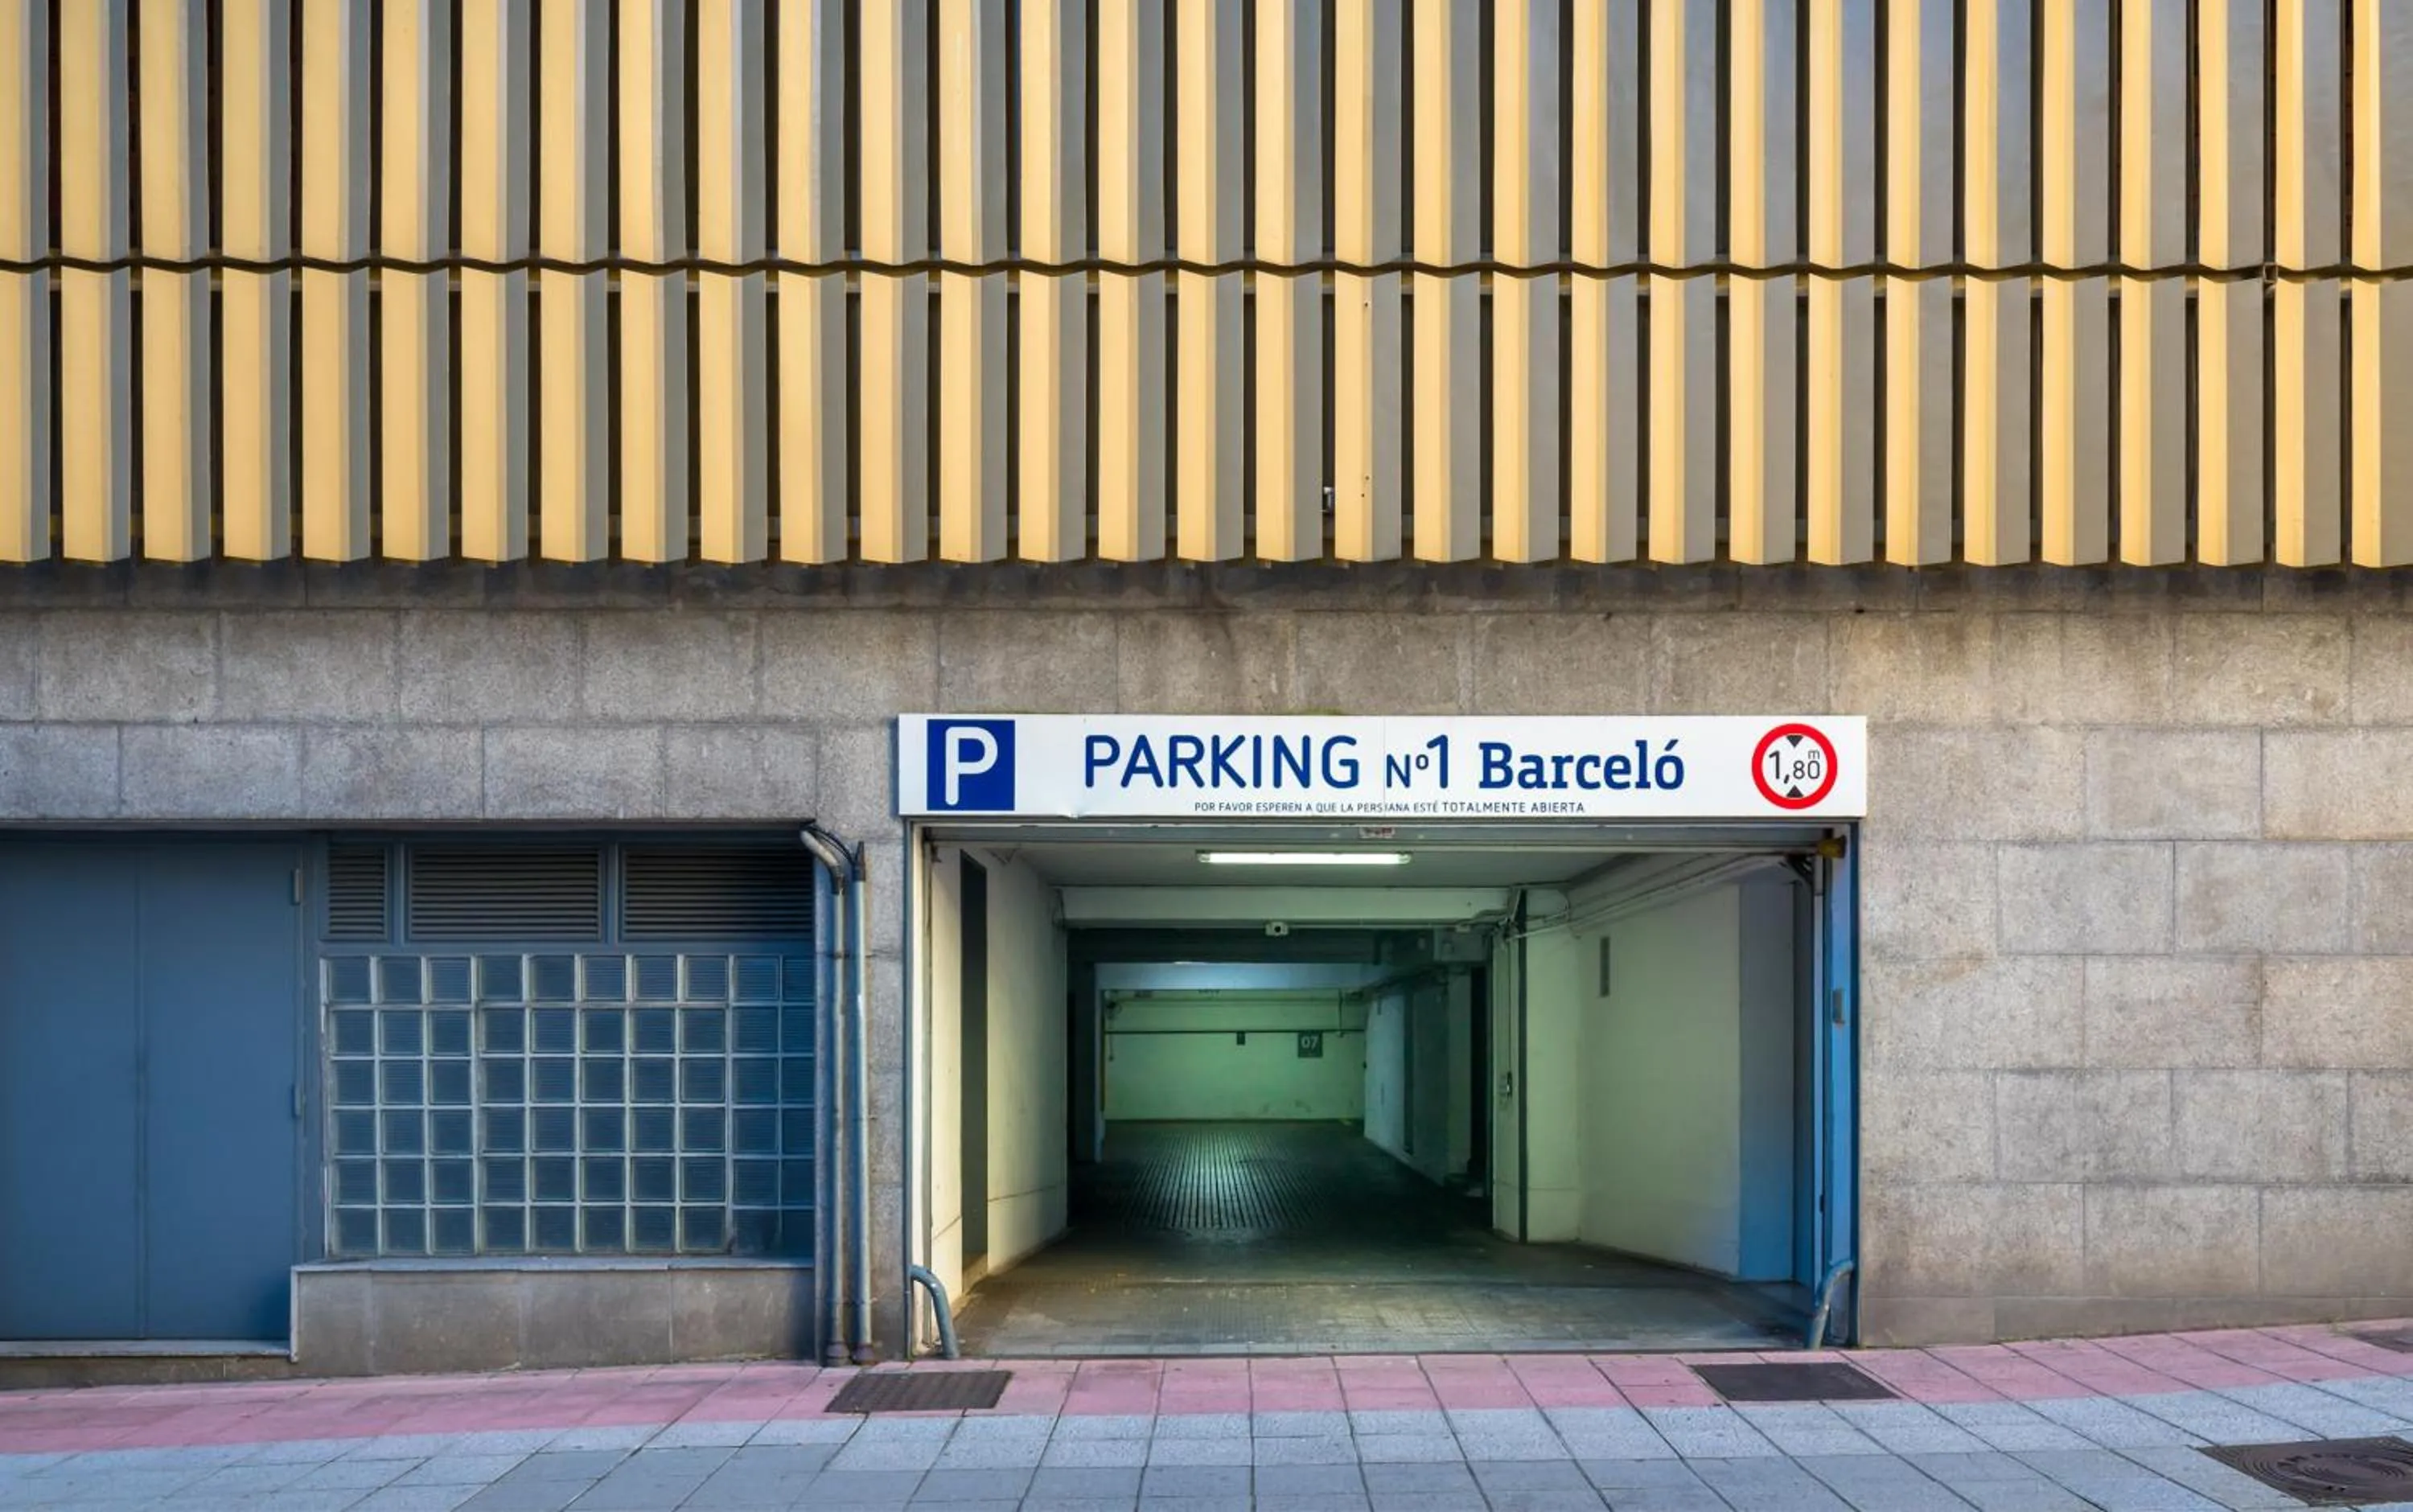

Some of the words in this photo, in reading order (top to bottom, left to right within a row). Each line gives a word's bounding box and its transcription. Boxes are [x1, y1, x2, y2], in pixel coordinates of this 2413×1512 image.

[944, 726, 998, 806] P
[1084, 734, 1359, 789] PARKING
[1478, 738, 1685, 791] Barceló
[1769, 750, 1820, 784] 1,80
[1194, 802, 1215, 812] POR
[1219, 802, 1252, 812] FAVOR
[1256, 802, 1302, 812] ESPEREN
[1305, 803, 1313, 812] A
[1316, 803, 1336, 814] QUE
[1340, 803, 1354, 812] LA
[1357, 803, 1411, 813] PERSIANA
[1413, 800, 1437, 813] ESTÉ
[1442, 802, 1526, 813] TOTALMENTE
[1531, 802, 1585, 813] ABIERTA
[1301, 1035, 1319, 1050] 07
